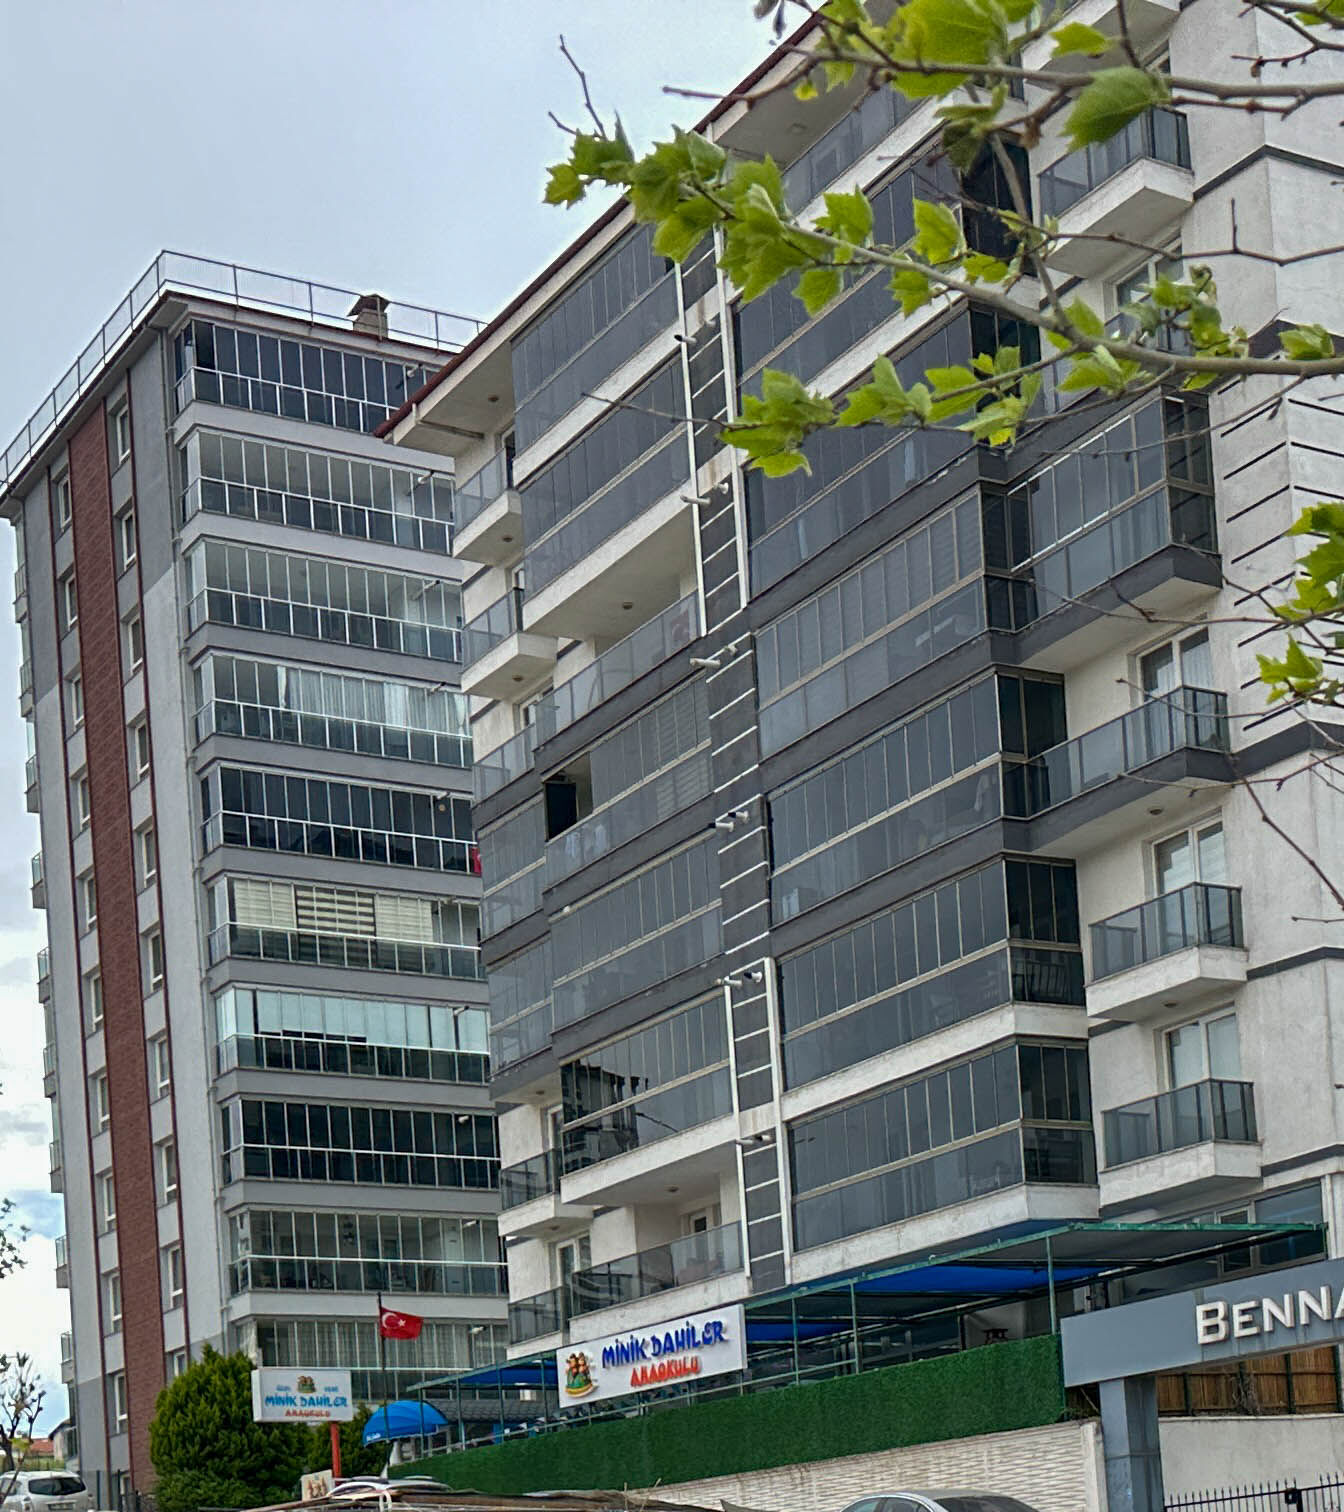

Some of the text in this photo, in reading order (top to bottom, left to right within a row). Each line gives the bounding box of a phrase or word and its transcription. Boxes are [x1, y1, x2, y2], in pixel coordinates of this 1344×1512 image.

[602, 1321, 727, 1368] MİNİK DAHİLER
[630, 1355, 700, 1388] ANAOKULU
